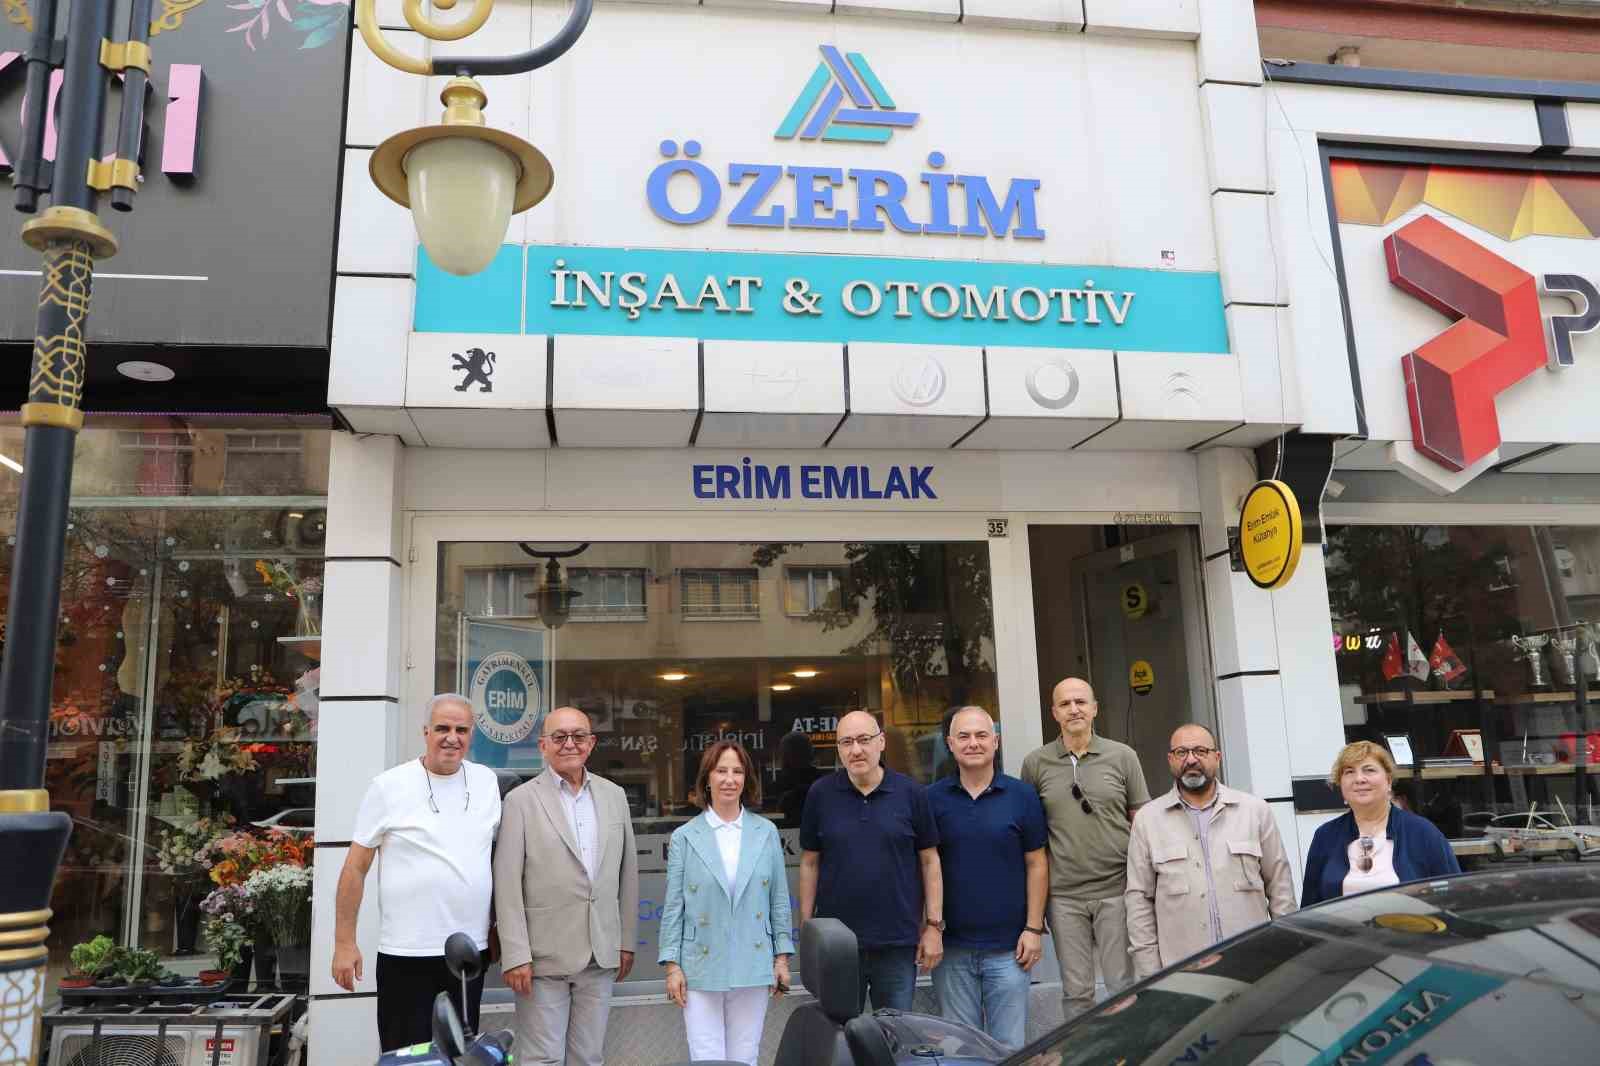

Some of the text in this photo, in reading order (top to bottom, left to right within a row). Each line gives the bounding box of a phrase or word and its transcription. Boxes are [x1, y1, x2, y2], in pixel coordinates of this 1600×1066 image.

[645, 139, 1046, 240] ÖZERİM
[550, 258, 1136, 325] İNŞAAT & OTOMOTİV
[692, 456, 938, 499] ERİM EMLAK
[988, 522, 1004, 534] 35
[488, 687, 525, 709] ERİM
